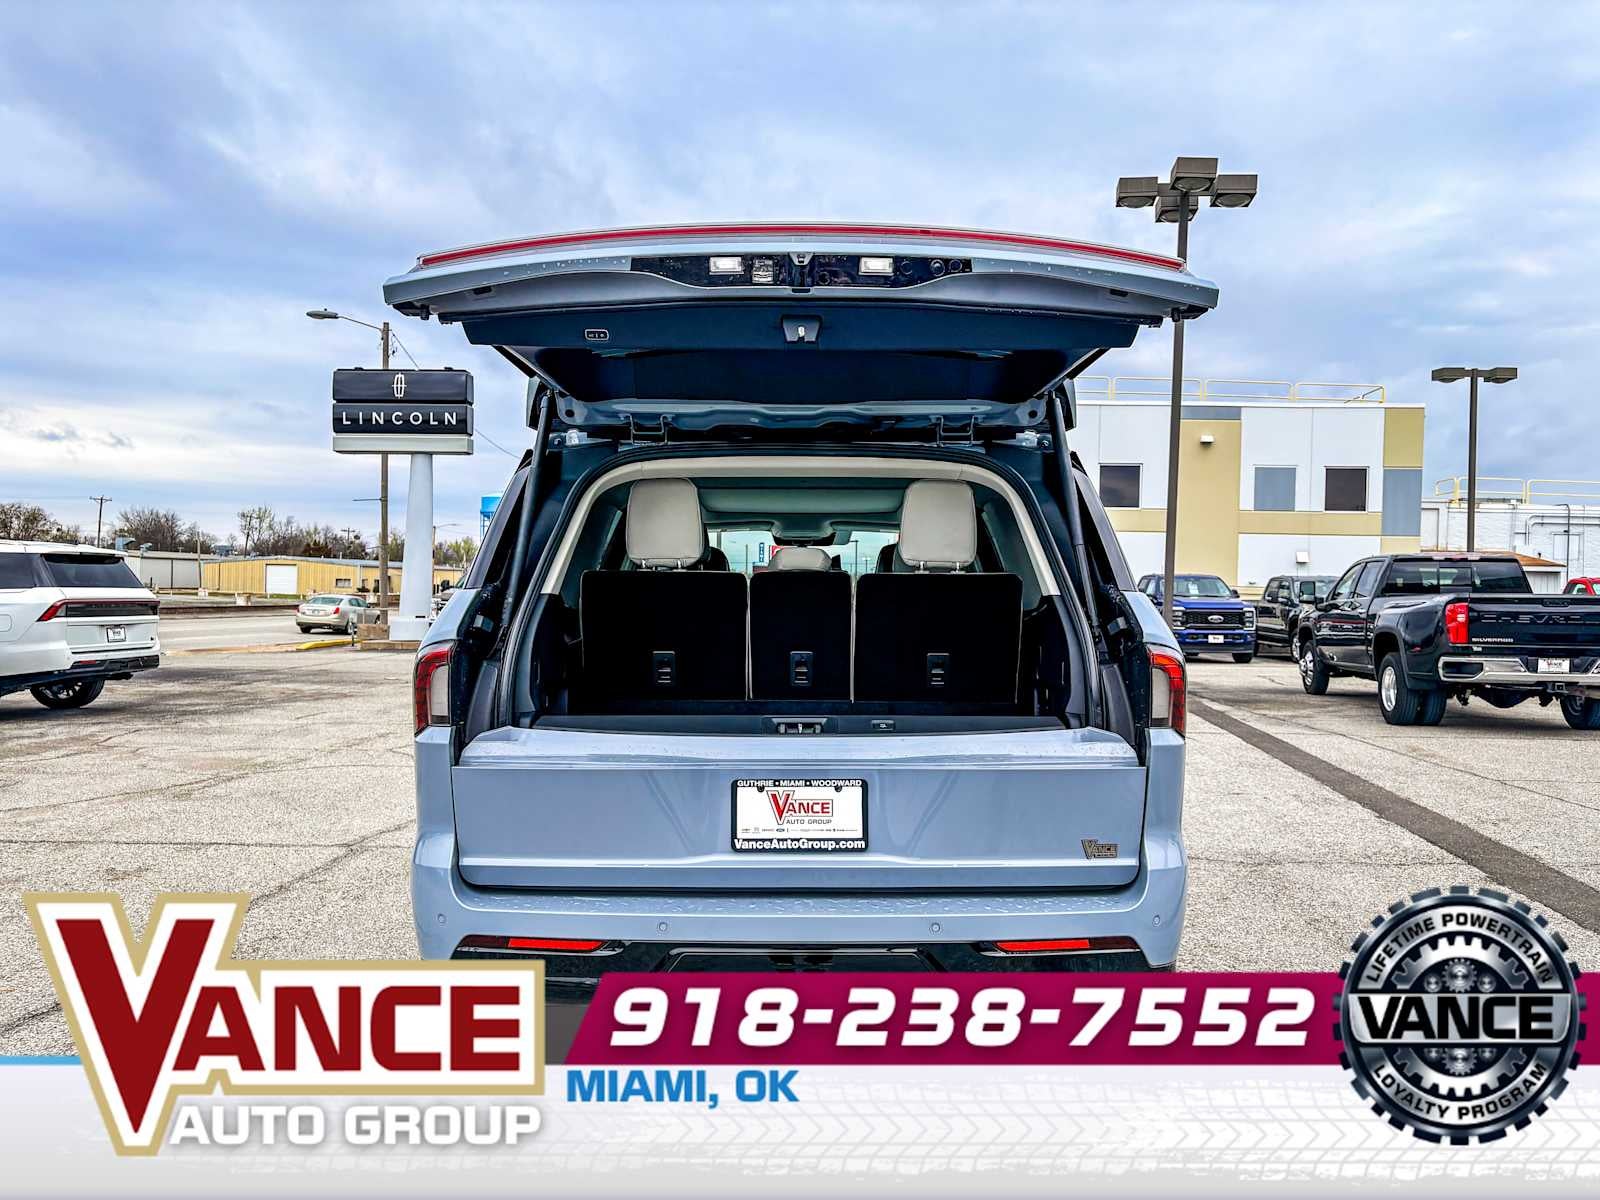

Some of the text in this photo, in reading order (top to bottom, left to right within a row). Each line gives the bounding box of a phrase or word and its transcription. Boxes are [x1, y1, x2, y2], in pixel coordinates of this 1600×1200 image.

[342, 411, 457, 425] LINCOLN
[737, 779, 862, 787] GUTHRIE MIAMI WOODWARD
[768, 791, 832, 822] VANCE
[734, 838, 866, 850] VanceAutoGroup.com
